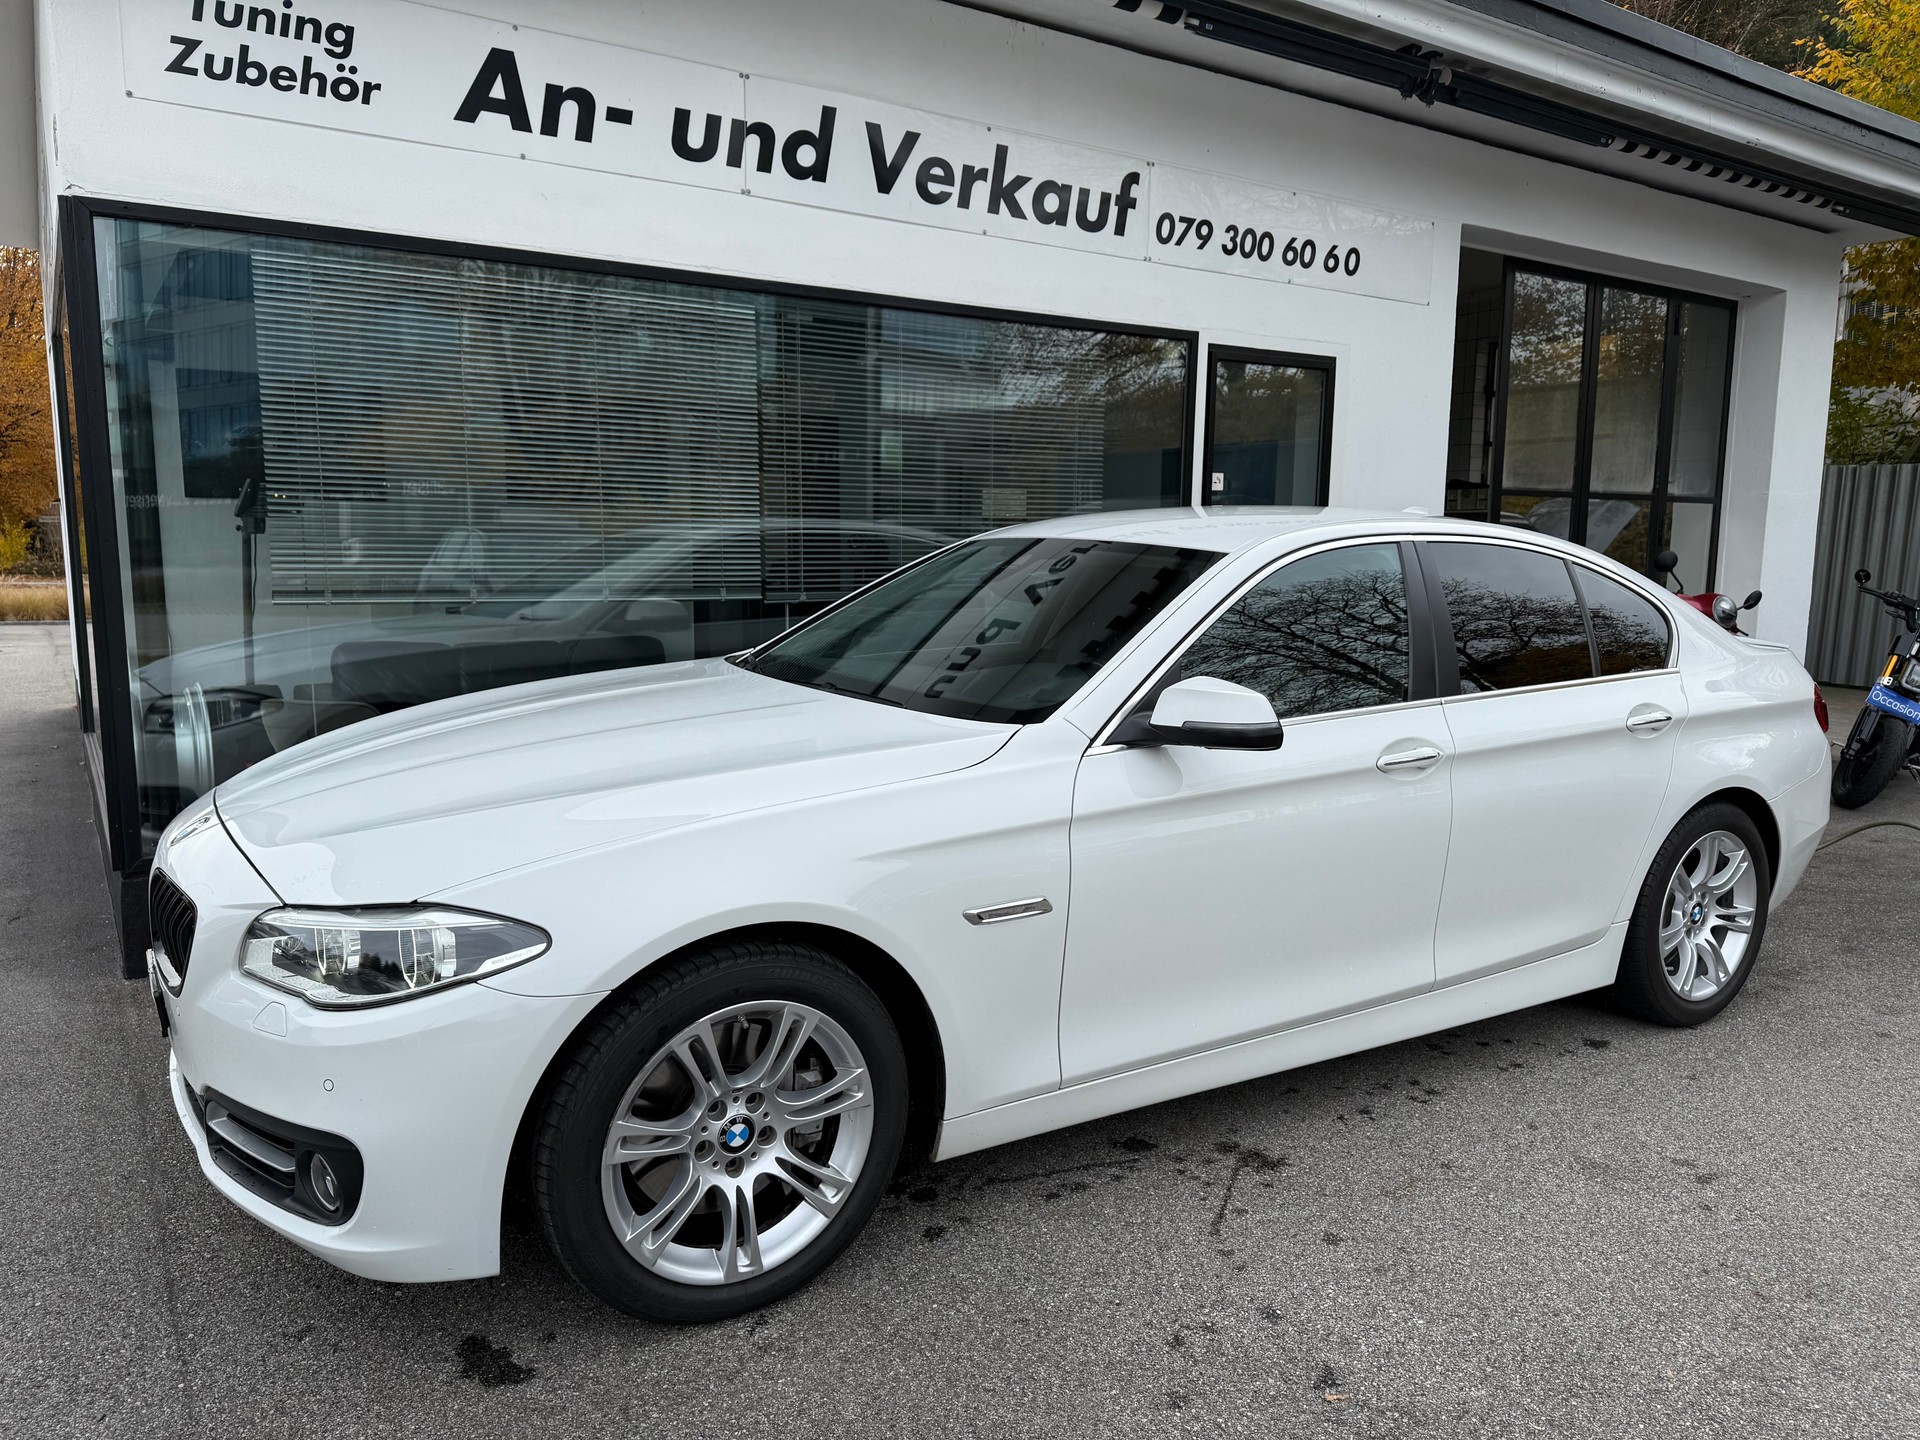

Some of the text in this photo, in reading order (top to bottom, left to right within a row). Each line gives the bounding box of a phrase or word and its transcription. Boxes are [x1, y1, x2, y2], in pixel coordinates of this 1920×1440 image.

[163, 35, 382, 106] Zubehör
[453, 47, 1141, 237] An- und Verkauf
[1155, 212, 1214, 250] 079
[1221, 224, 1275, 262] 300
[1281, 237, 1317, 270] 60
[1872, 690, 1920, 721] Occasion
[719, 1116, 744, 1143] BMW
